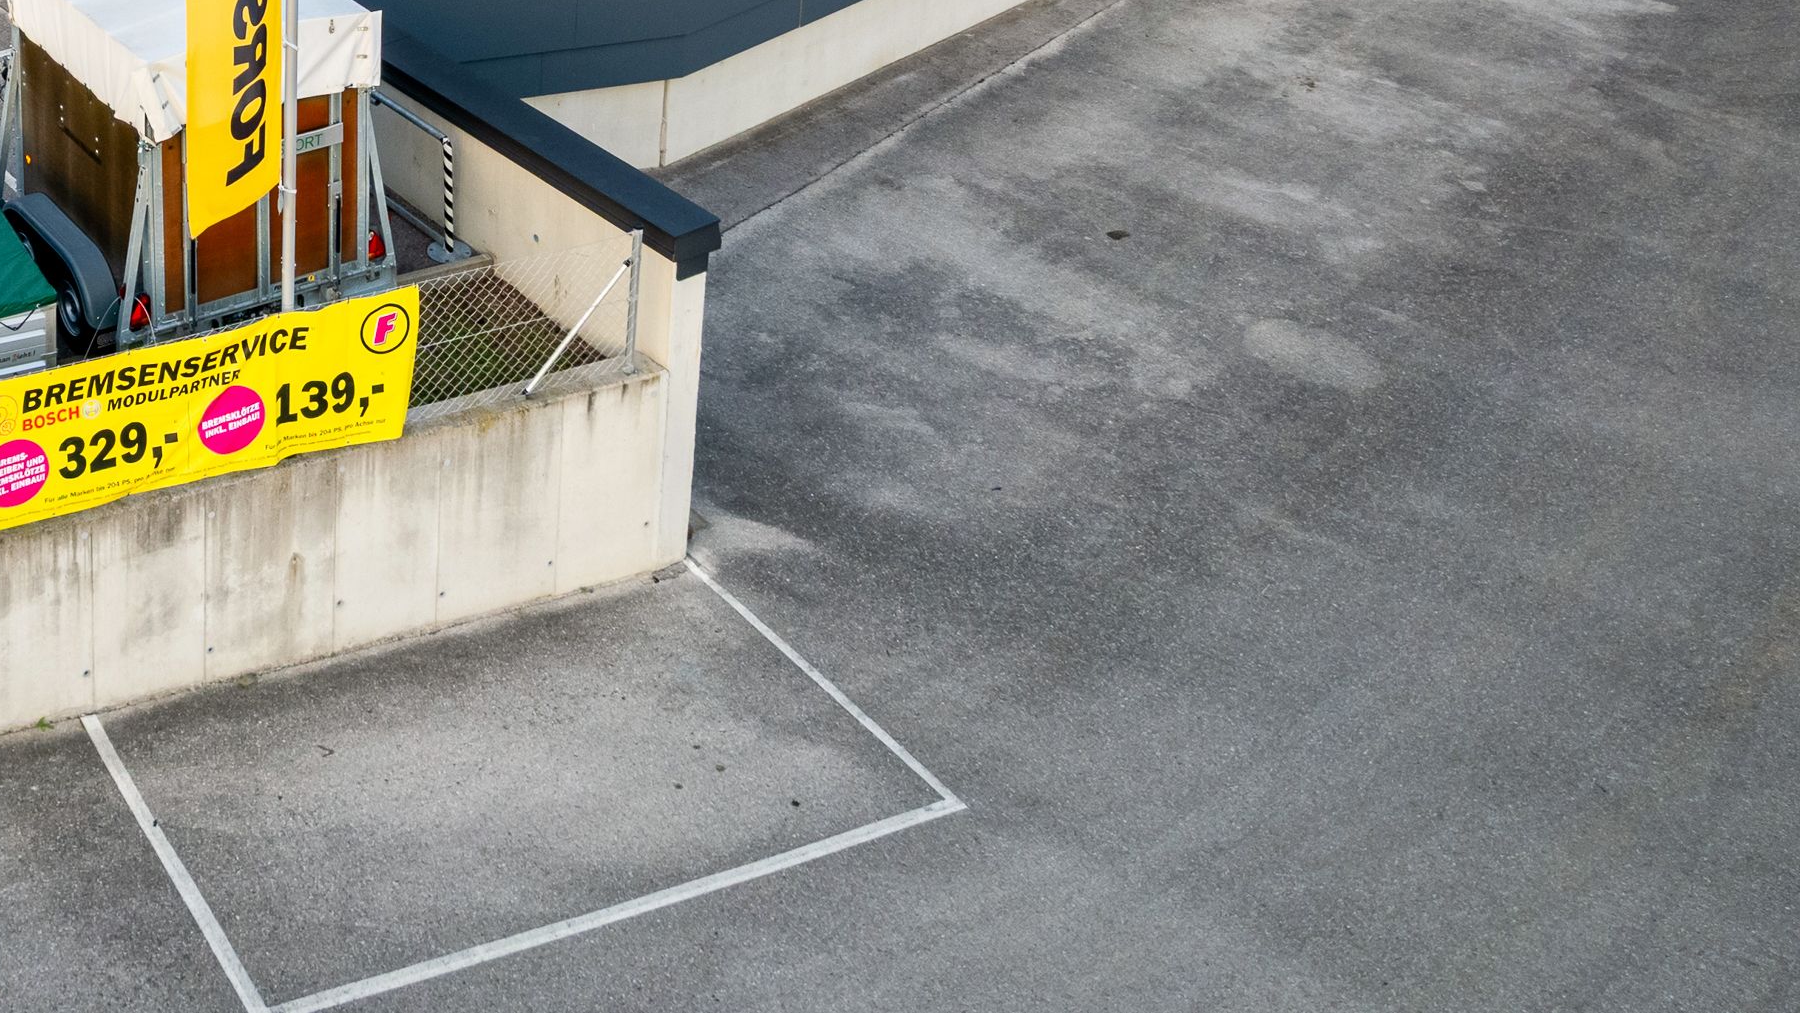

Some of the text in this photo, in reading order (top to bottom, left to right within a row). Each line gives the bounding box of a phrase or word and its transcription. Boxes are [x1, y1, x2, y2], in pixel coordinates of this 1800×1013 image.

[374, 312, 397, 345] F
[22, 327, 309, 413] BREMSENSERVICE
[22, 369, 240, 431] BOSCH MODULPARTNER
[202, 402, 260, 430] BREMSKLÖTZE
[276, 371, 385, 428] 139,-
[205, 412, 260, 439] INKL. EINBAU!
[26, 455, 44, 468] UND
[58, 421, 178, 480] 329,-
[11, 473, 46, 491] EINBAU!
